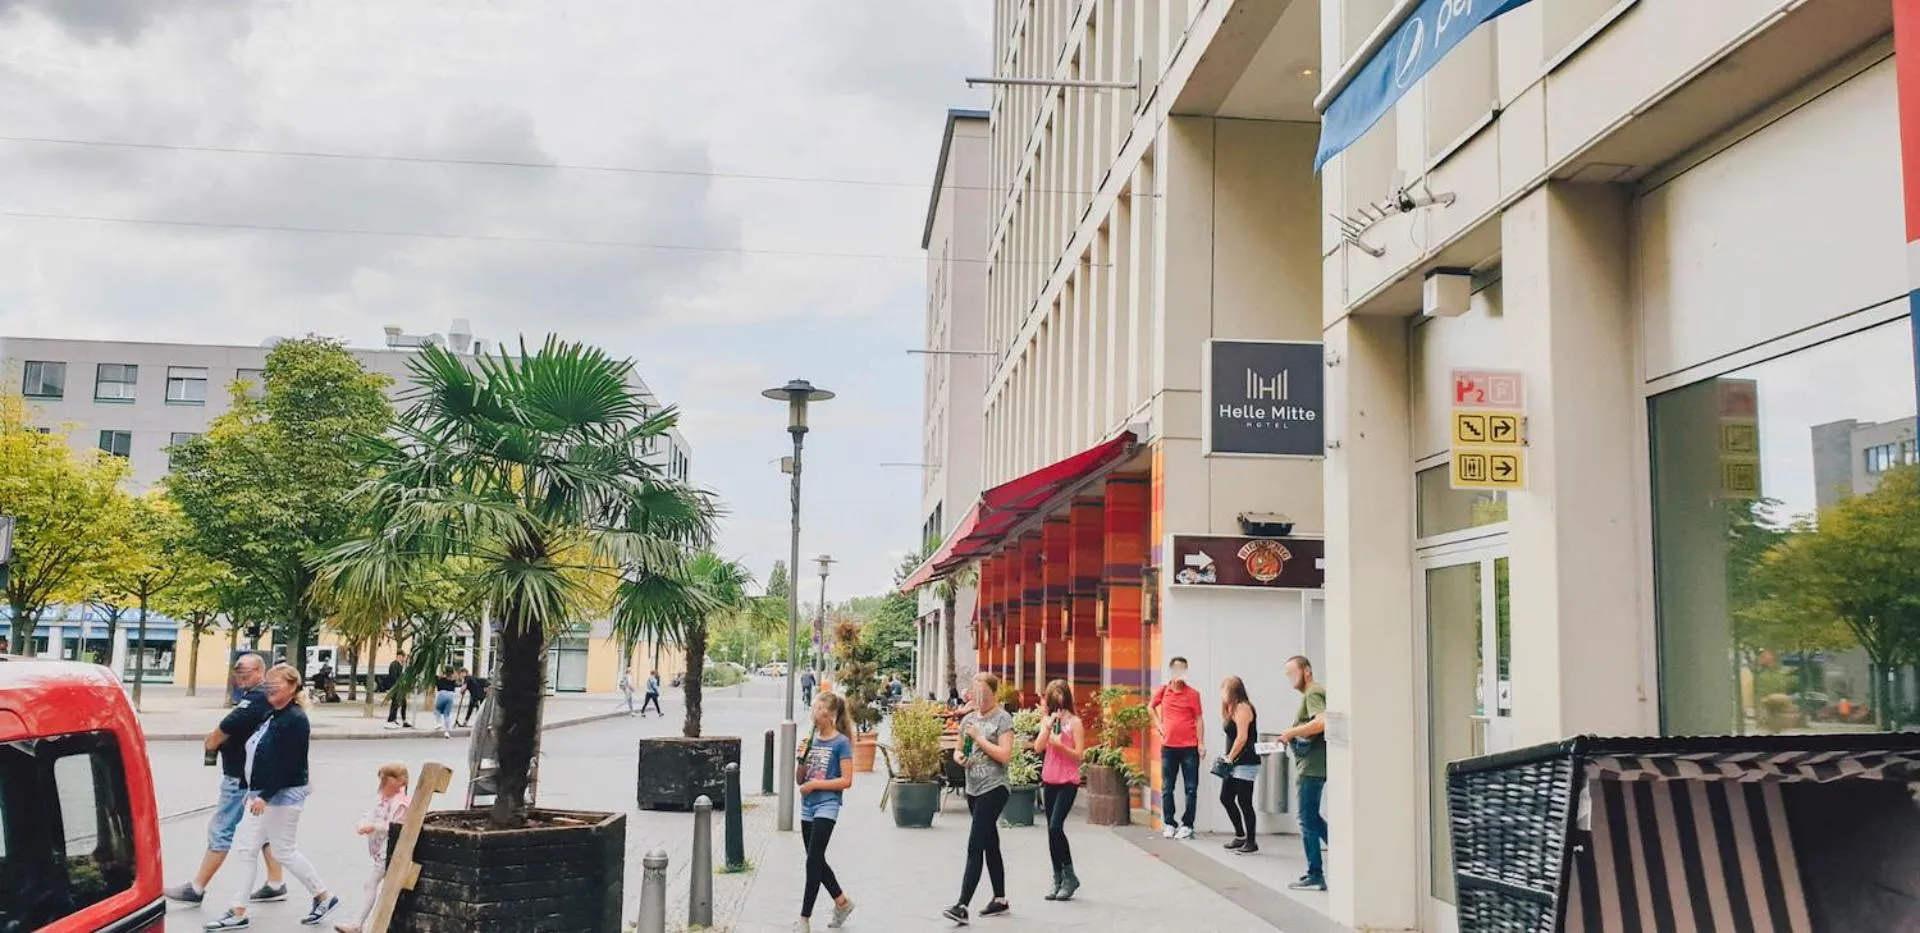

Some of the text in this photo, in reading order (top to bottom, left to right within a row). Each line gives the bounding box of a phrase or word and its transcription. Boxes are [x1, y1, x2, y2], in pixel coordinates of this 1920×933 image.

[1219, 404, 1316, 421] Helle Mitte
[1246, 421, 1289, 429] HOTEL
